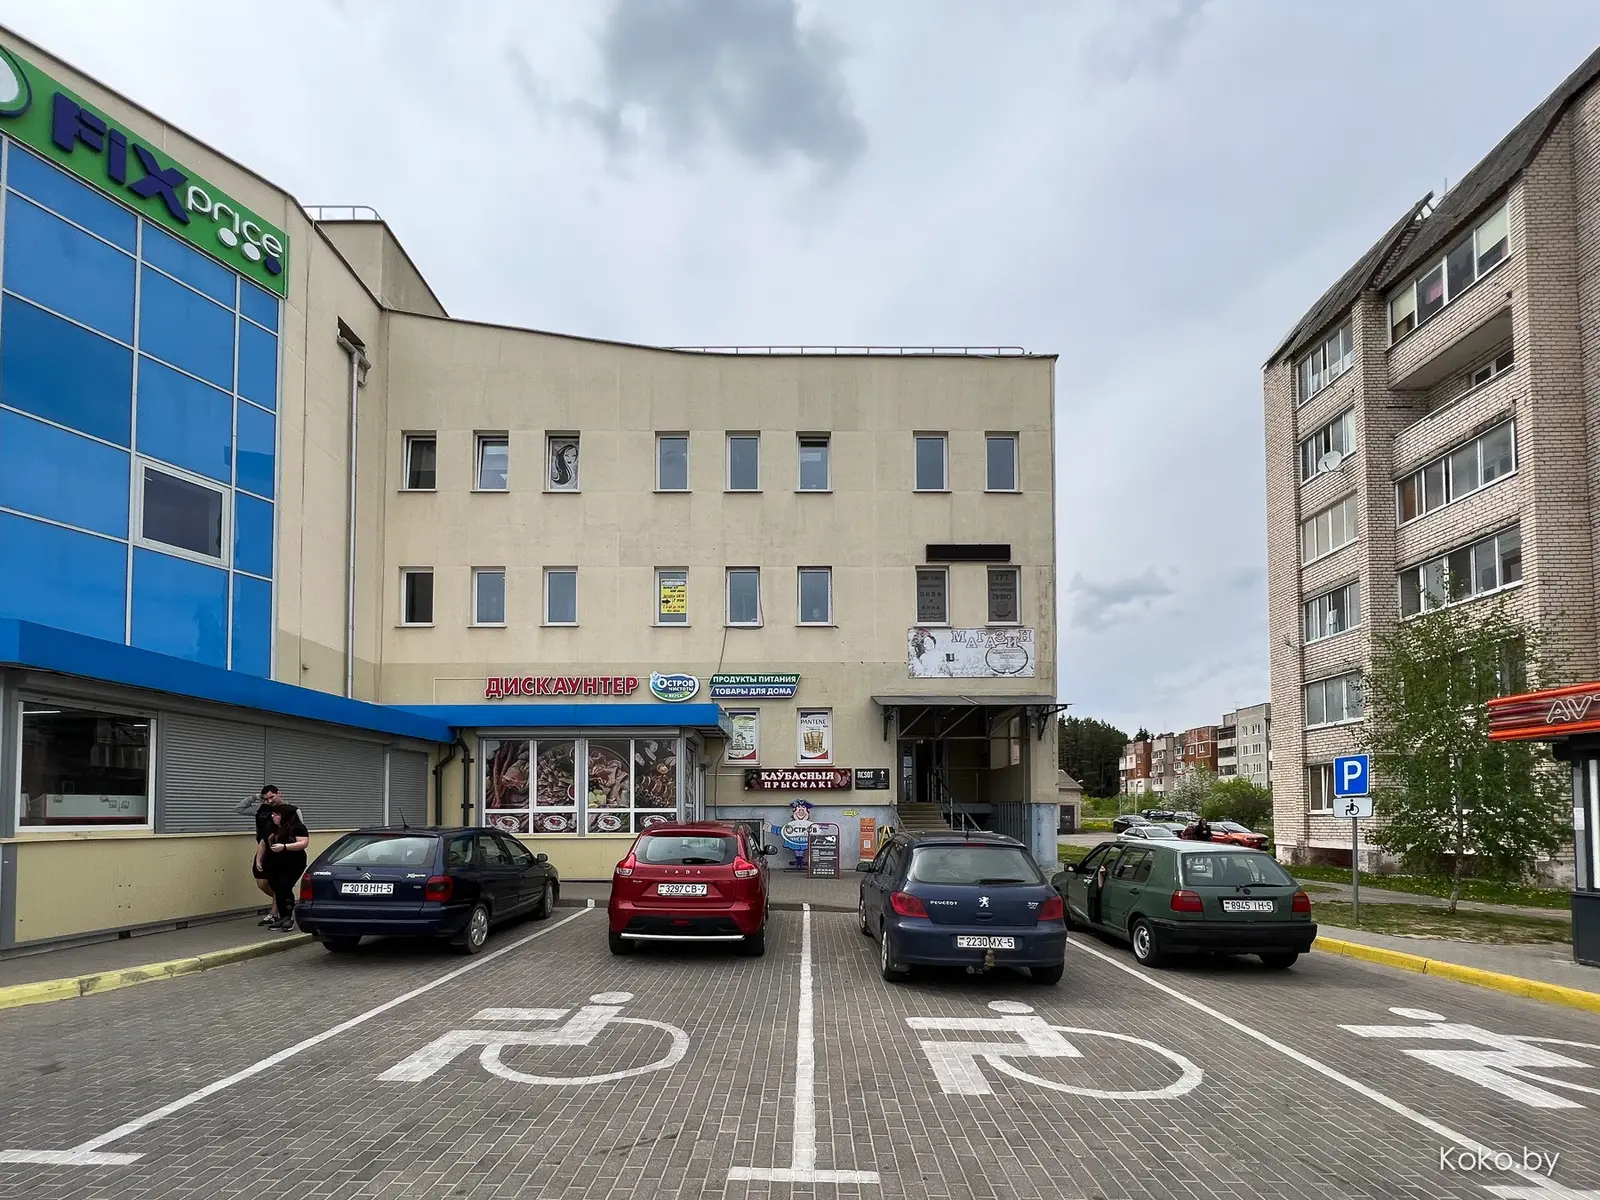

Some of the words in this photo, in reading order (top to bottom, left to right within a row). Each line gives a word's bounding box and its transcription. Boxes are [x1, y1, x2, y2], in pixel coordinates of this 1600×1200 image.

[187, 185, 283, 258] price
[951, 630, 1031, 648] МАГАЗИН
[485, 676, 639, 698] ДИСКАУНТЕР
[657, 677, 694, 688] ОСТРОВ
[713, 675, 757, 683] ПРОДУКТЫ
[758, 675, 796, 683] ПИТАНИЯ
[715, 687, 749, 695] ТОВАРЫ
[749, 687, 767, 695] ДЛЯ
[767, 687, 792, 695] ДОМА
[1546, 694, 1600, 723] AV
[761, 769, 834, 780] КАЎБАСНЫЯ
[1343, 760, 1362, 791] P
